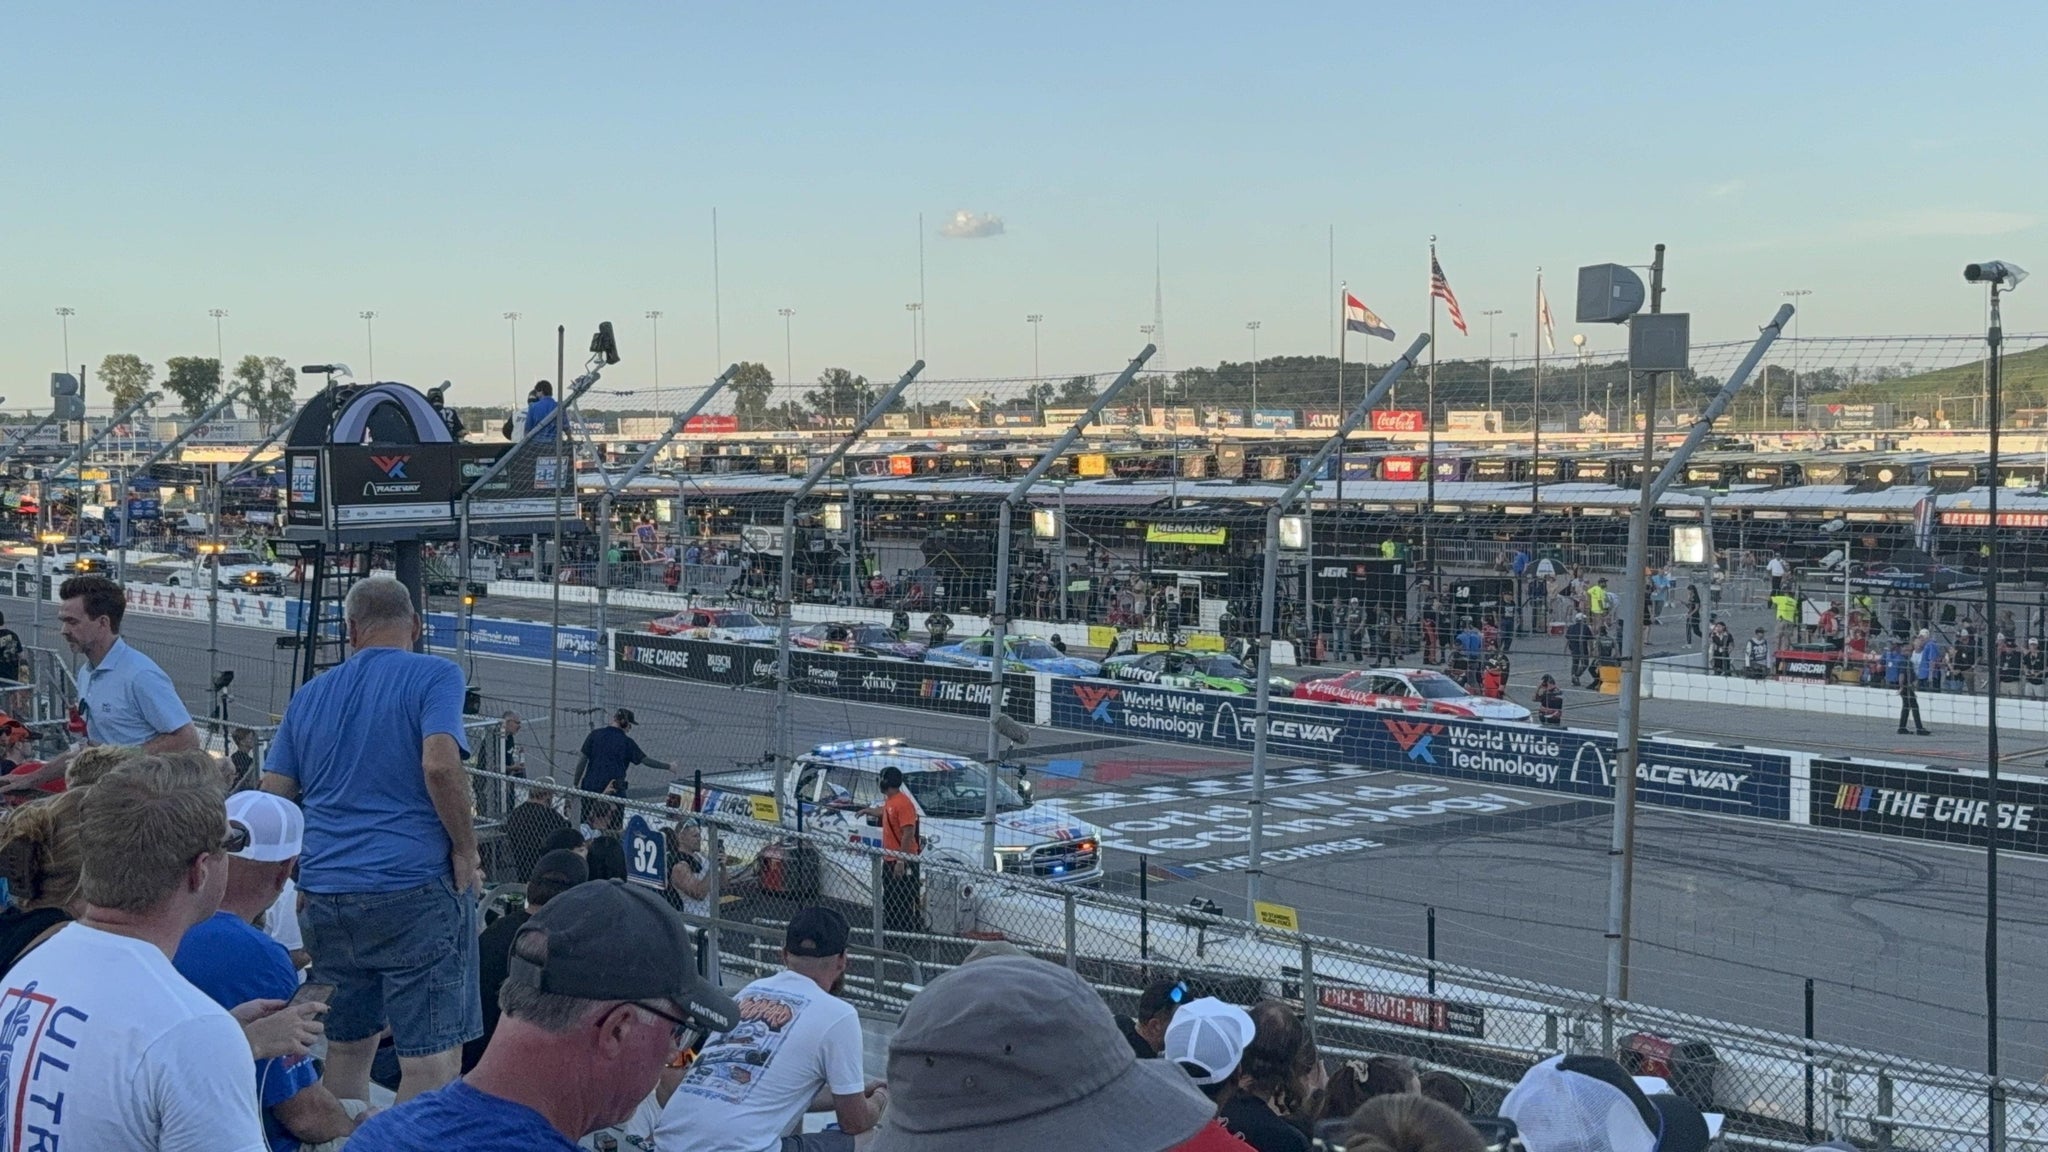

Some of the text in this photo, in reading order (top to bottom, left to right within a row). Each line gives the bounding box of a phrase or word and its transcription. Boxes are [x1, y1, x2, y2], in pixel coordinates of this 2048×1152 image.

[1377, 411, 1416, 430] Coca-Cola
[376, 484, 420, 493] RACEWAY
[1154, 523, 1220, 533] MENARDS
[1942, 512, 1997, 526] GATEWA
[1318, 567, 1348, 578] JGR
[637, 647, 689, 668] THE CHASE
[708, 654, 731, 667] BUSCH
[1790, 662, 1826, 673] NASCAR
[808, 665, 838, 679] Freeway
[862, 671, 896, 693] xfinity
[940, 681, 1010, 706] THE CHAE
[1122, 690, 1204, 715] World Wide
[1317, 684, 1370, 702] PHOENIX
[1122, 709, 1204, 739] Technology
[1448, 725, 1560, 757] World Wide
[1448, 747, 1559, 784] Technology
[1266, 784, 1449, 810] Wide
[1877, 789, 2034, 832] THE CHASE
[1100, 793, 1532, 855] Technology
[633, 837, 659, 875] 32
[1183, 837, 1385, 873] THE CHASE
[690, 1001, 728, 1027] PANTHERS
